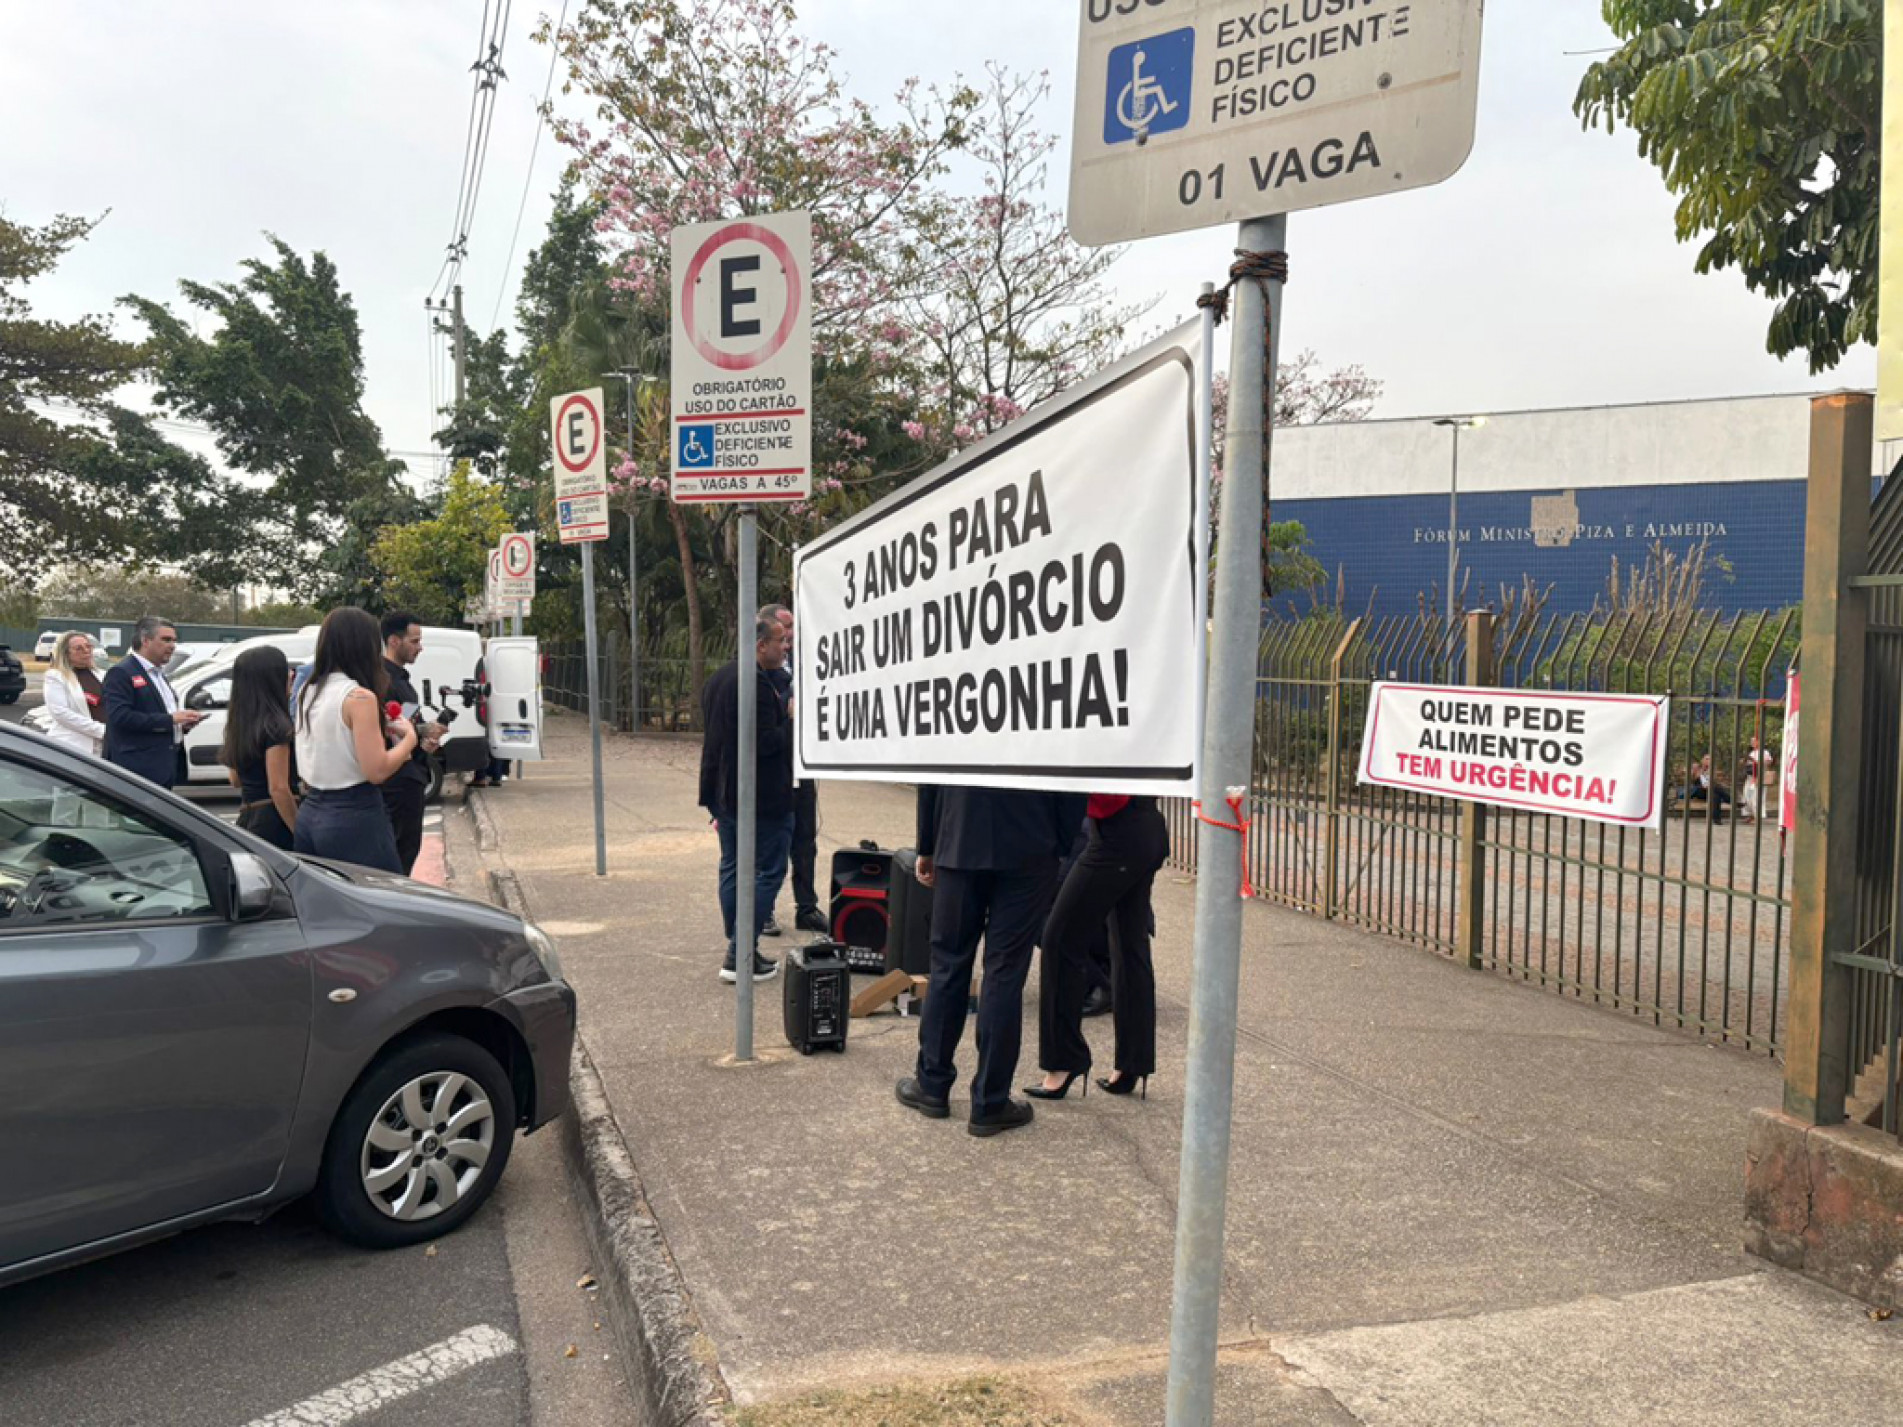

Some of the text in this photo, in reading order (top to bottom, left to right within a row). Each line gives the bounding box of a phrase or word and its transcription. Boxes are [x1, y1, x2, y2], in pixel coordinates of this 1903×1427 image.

[1214, 6, 1410, 86] DEFICIENTE
[1212, 73, 1316, 123] FÍSICO
[1179, 130, 1381, 205] 01 VAGA
[720, 255, 761, 338] E
[685, 394, 796, 413] USO DO CARTÃO
[693, 376, 786, 396] OBRIGATÓRIO
[568, 411, 585, 456] E
[715, 419, 791, 435] EXCLUSIVO
[715, 436, 793, 452] DEFICIENTE
[715, 453, 759, 467] FÍSICO
[700, 477, 748, 491] VAGAS
[756, 477, 767, 489] A
[844, 469, 1052, 609] 3 ANOS PARA
[1575, 523, 1615, 539] PIZA
[1625, 523, 1635, 538] E
[1643, 521, 1727, 538] ALMEIDA
[816, 541, 1125, 680] SAIR UM DIVÓRCIO
[817, 647, 1129, 741] É UMA VERGONHA!
[1420, 699, 1586, 734] QUEM PEDE
[1418, 728, 1584, 766] ALIMENTOS
[1396, 752, 1618, 804] TEM URGÊNCIA!
